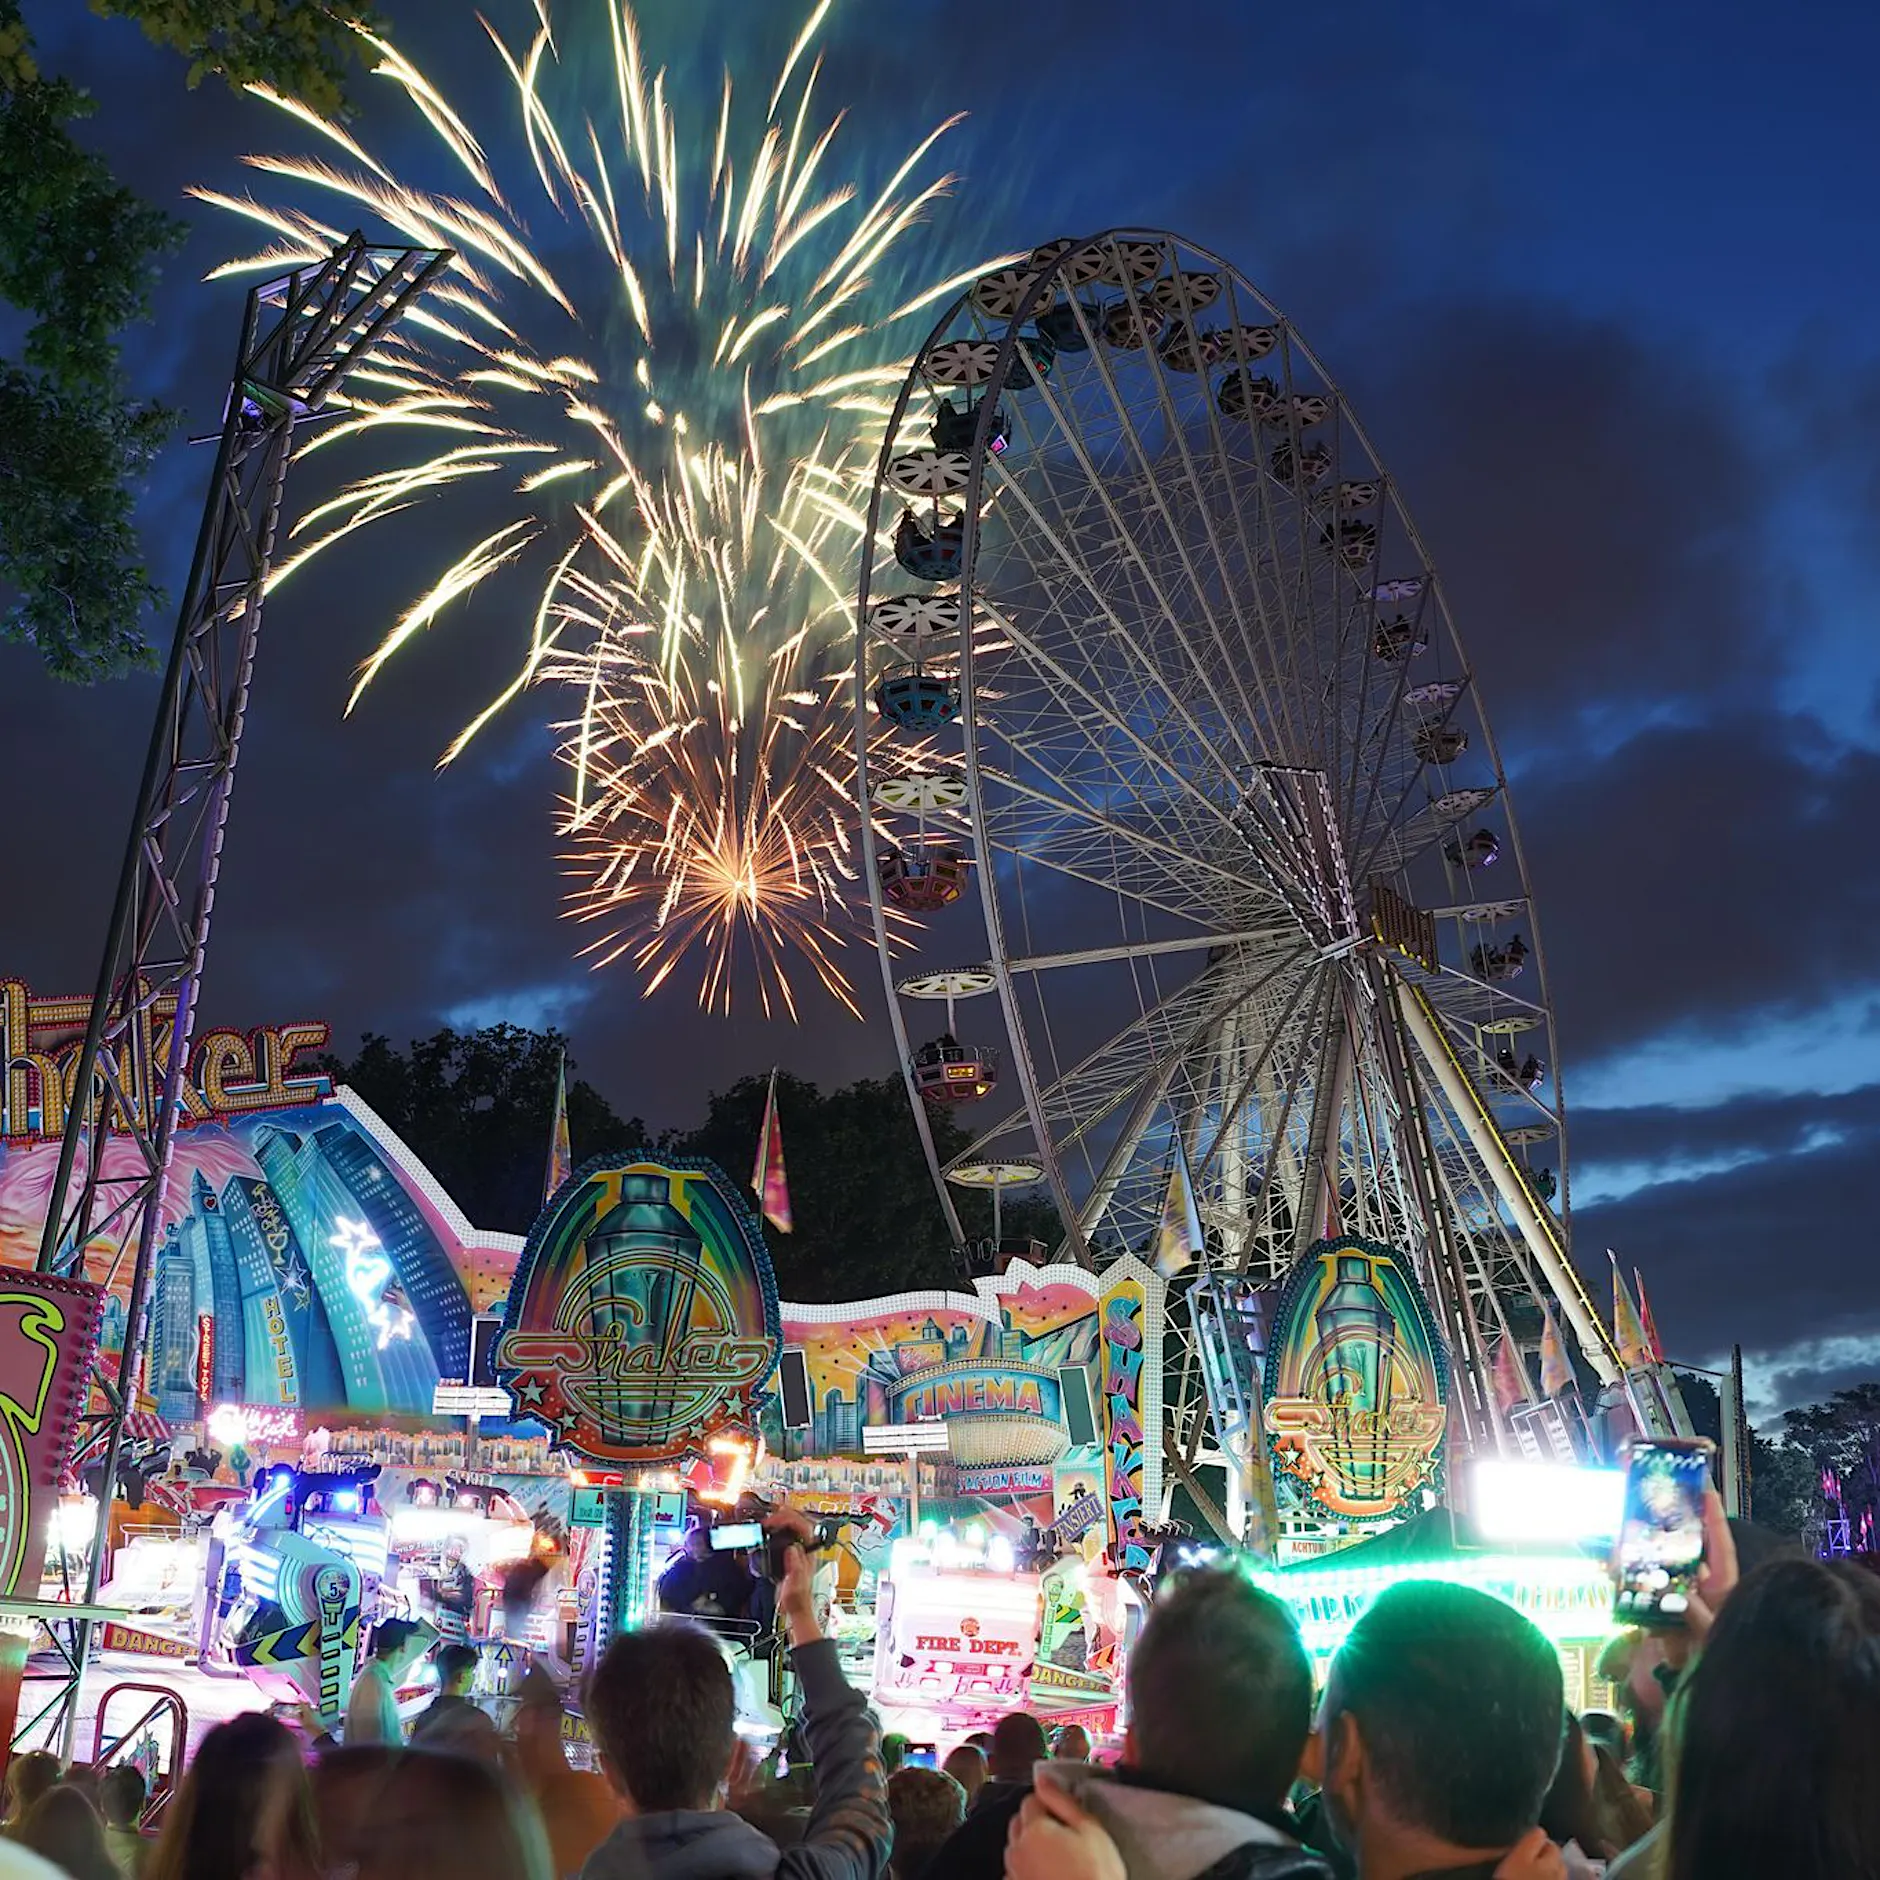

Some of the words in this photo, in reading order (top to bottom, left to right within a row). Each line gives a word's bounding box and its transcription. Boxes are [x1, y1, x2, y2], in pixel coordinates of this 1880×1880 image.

[0, 976, 335, 1142] haker
[504, 1281, 769, 1381] Shaker
[263, 1295, 297, 1403] HOTEL
[200, 1369, 210, 1401] TOYS
[904, 1376, 1043, 1424] CINEMA
[965, 1471, 1010, 1491] ACTION
[1012, 1470, 1043, 1488] FILM
[1291, 1541, 1328, 1554] ACHTUN
[329, 1582, 338, 1597] 5
[916, 1635, 961, 1653] FIRE
[969, 1639, 1023, 1657] DEPT.
